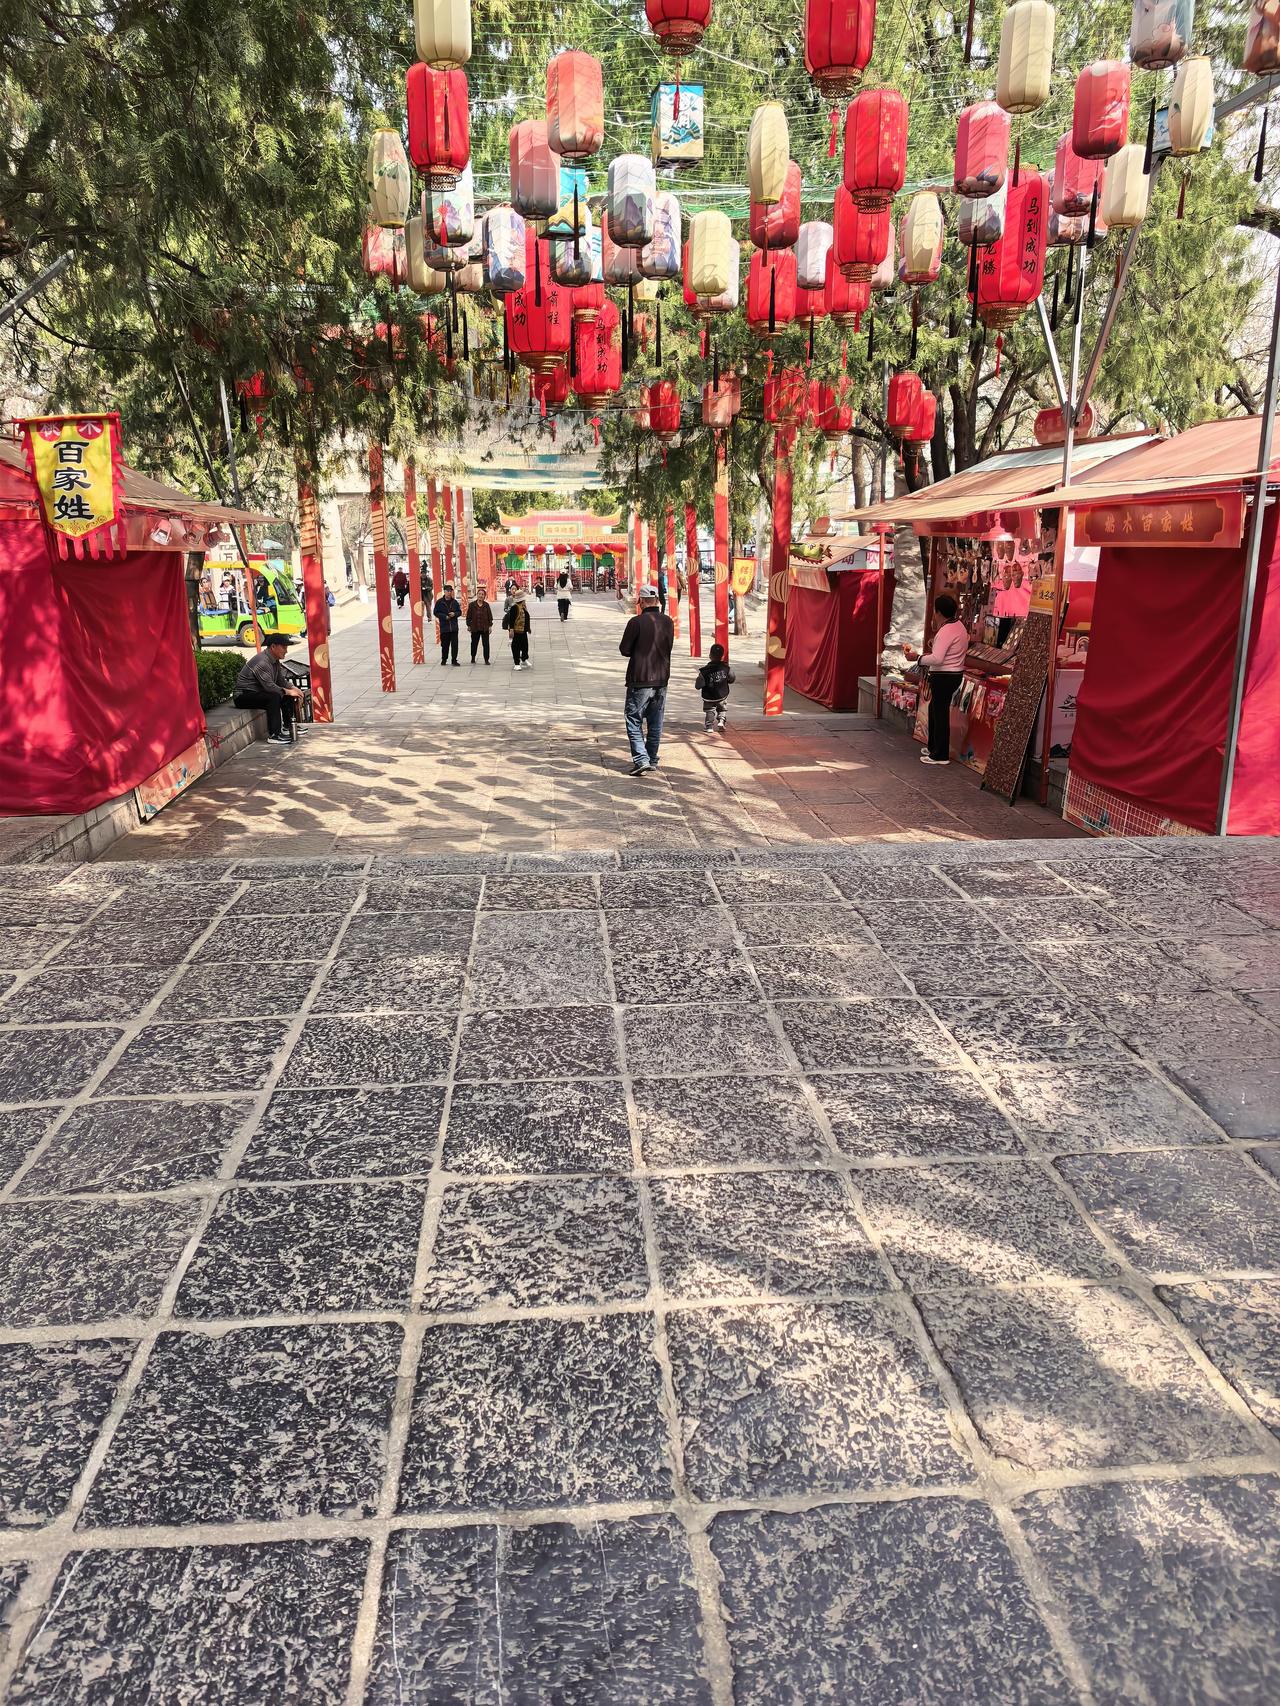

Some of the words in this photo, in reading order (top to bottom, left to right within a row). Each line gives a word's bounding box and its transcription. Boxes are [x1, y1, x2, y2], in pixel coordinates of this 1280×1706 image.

[1023, 198, 1039, 274] 马到成功
[51, 441, 95, 520] 百家姓
